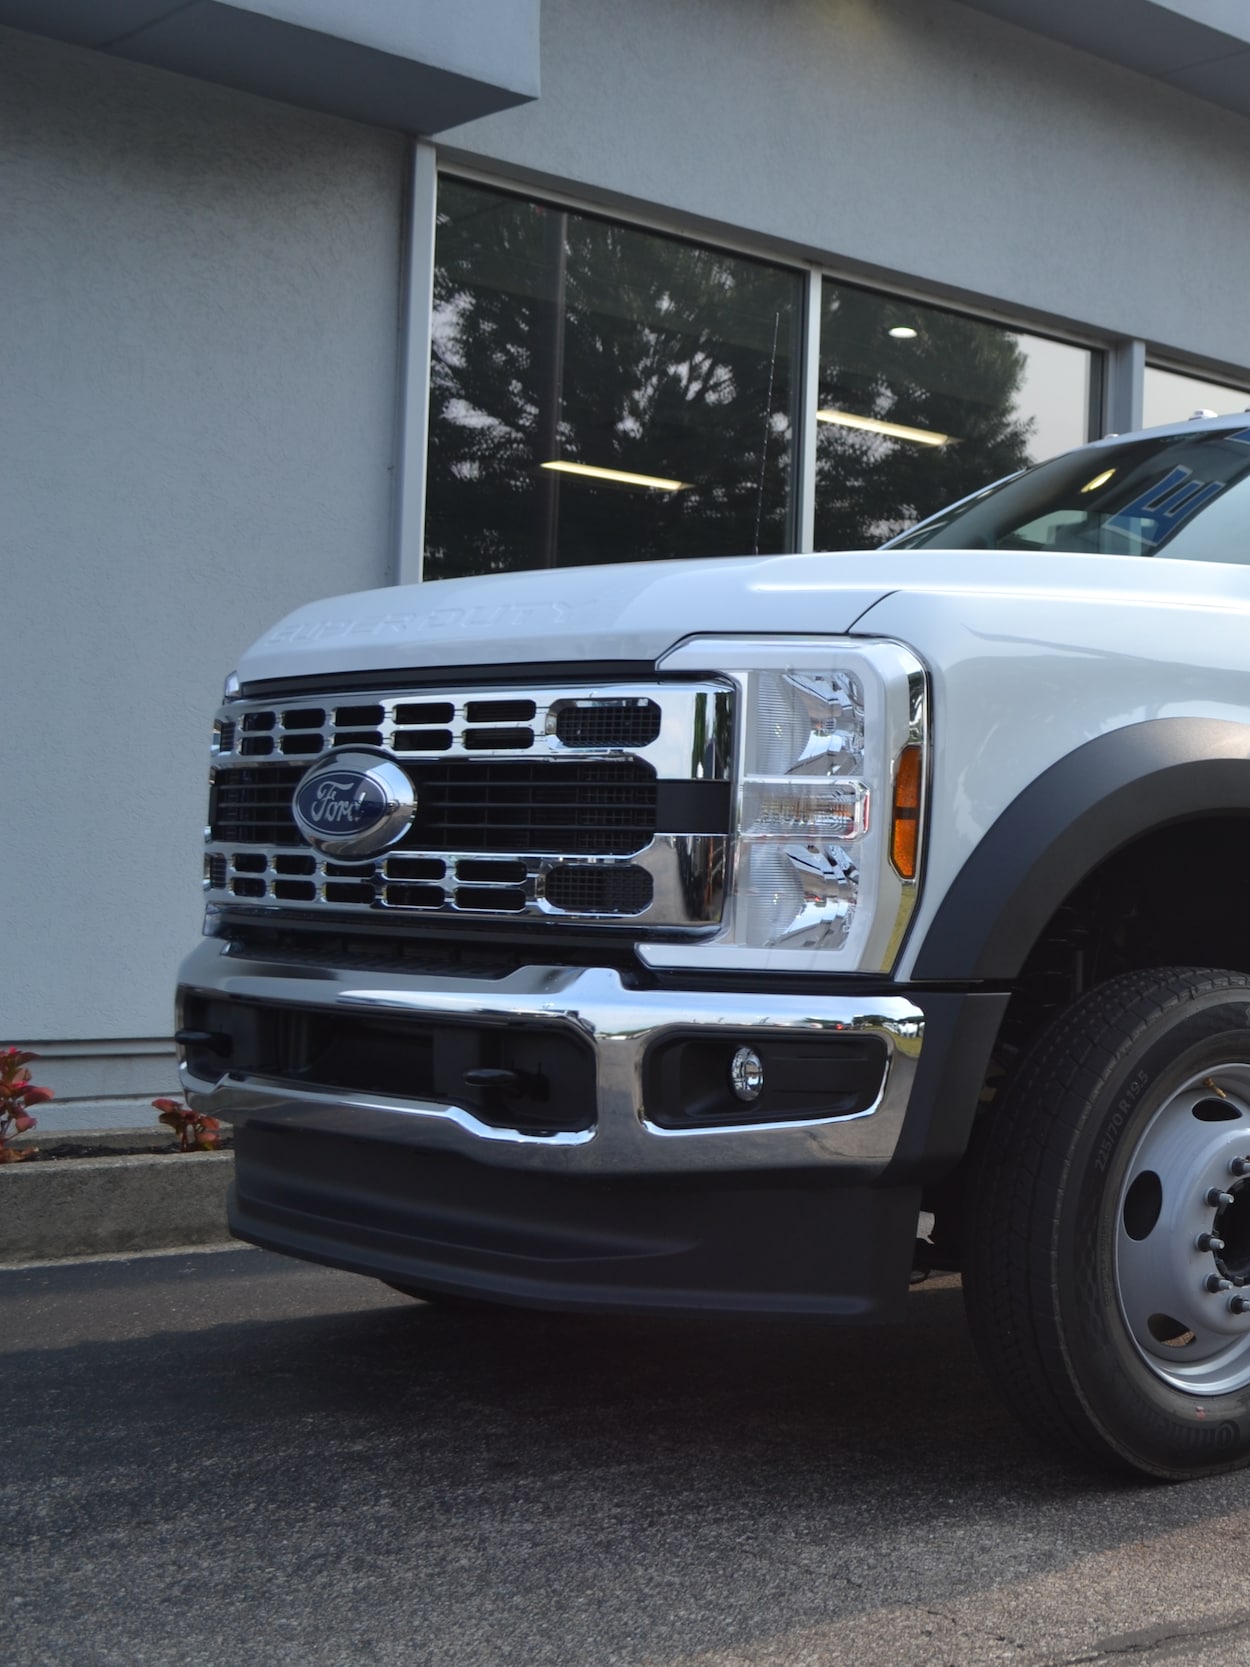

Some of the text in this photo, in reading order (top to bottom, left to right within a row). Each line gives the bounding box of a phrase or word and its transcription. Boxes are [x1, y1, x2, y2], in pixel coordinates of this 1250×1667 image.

[310, 780, 368, 822] Ford
[1095, 1069, 1149, 1173] 225/70 R 19.5
